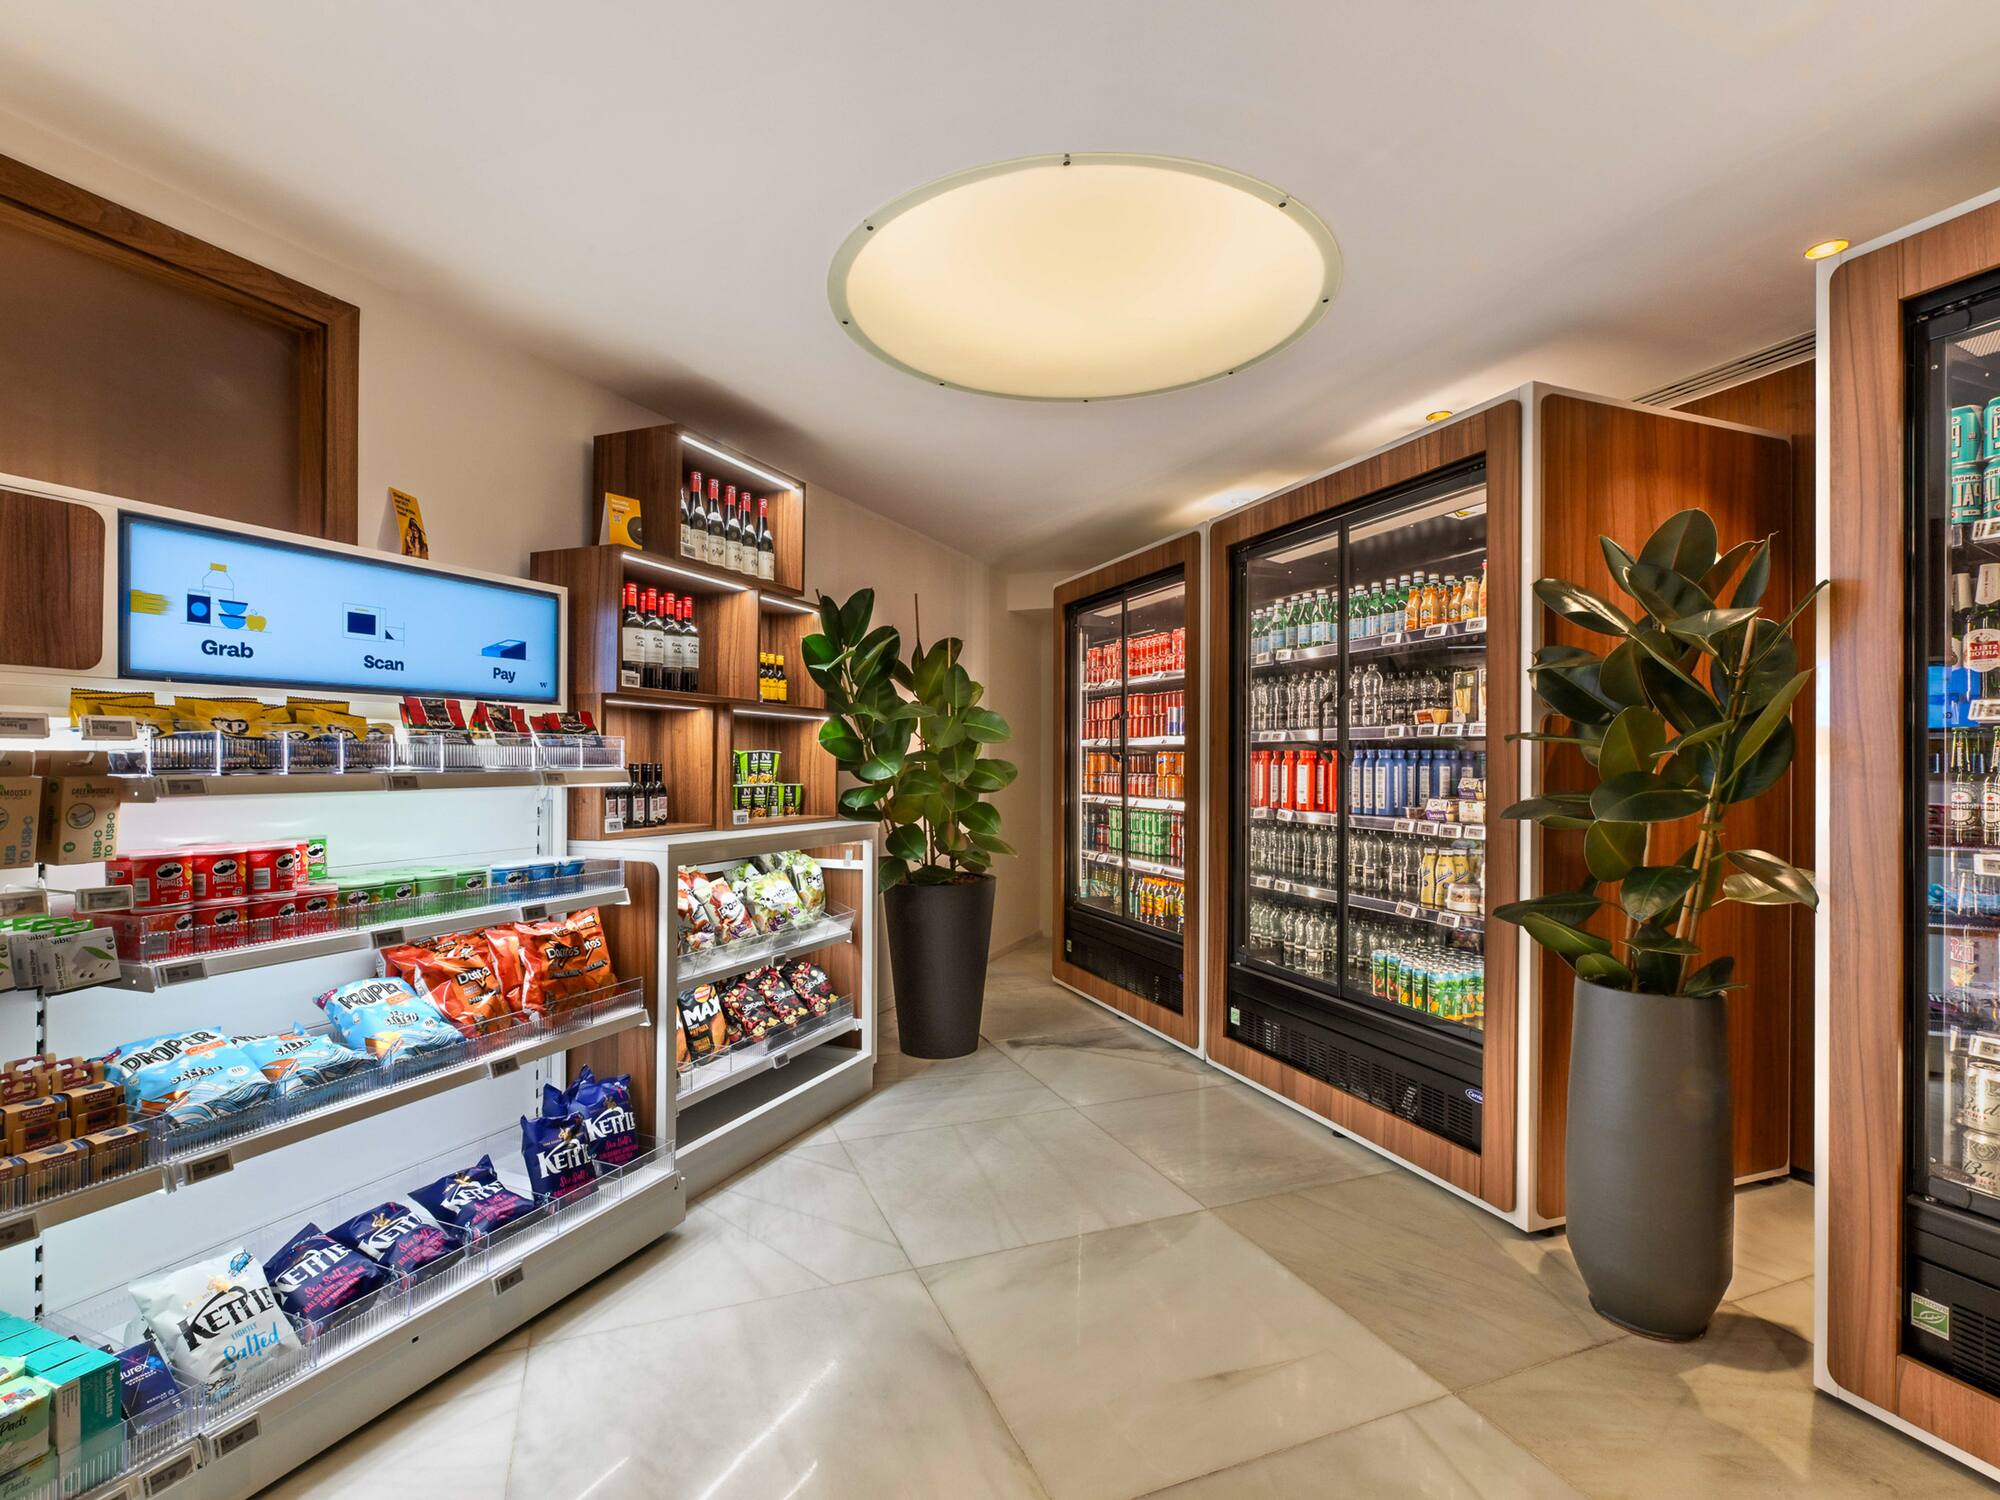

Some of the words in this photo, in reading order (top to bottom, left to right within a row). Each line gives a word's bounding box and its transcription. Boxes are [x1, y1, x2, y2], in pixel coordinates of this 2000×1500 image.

[201, 640, 254, 659] Grab
[364, 655, 405, 671] Scan
[493, 667, 516, 683] Pay
[210, 717, 249, 736] KP
[105, 812, 115, 840] USB-C
[92, 830, 102, 858] USB-C
[104, 844, 113, 857] TO
[156, 877, 184, 889] PRINGLES
[212, 873, 238, 885] PRINGLES
[584, 938, 602, 950] itos
[683, 995, 722, 1027] MAX
[120, 1031, 217, 1072] PROPER
[272, 1242, 353, 1305] KETTLE
[304, 1282, 323, 1297] Sea
[177, 1285, 275, 1352] KETTLE
[231, 1321, 258, 1340] LIGHTLY
[223, 1321, 281, 1371] Salted
[0, 1415, 28, 1437] Pads
